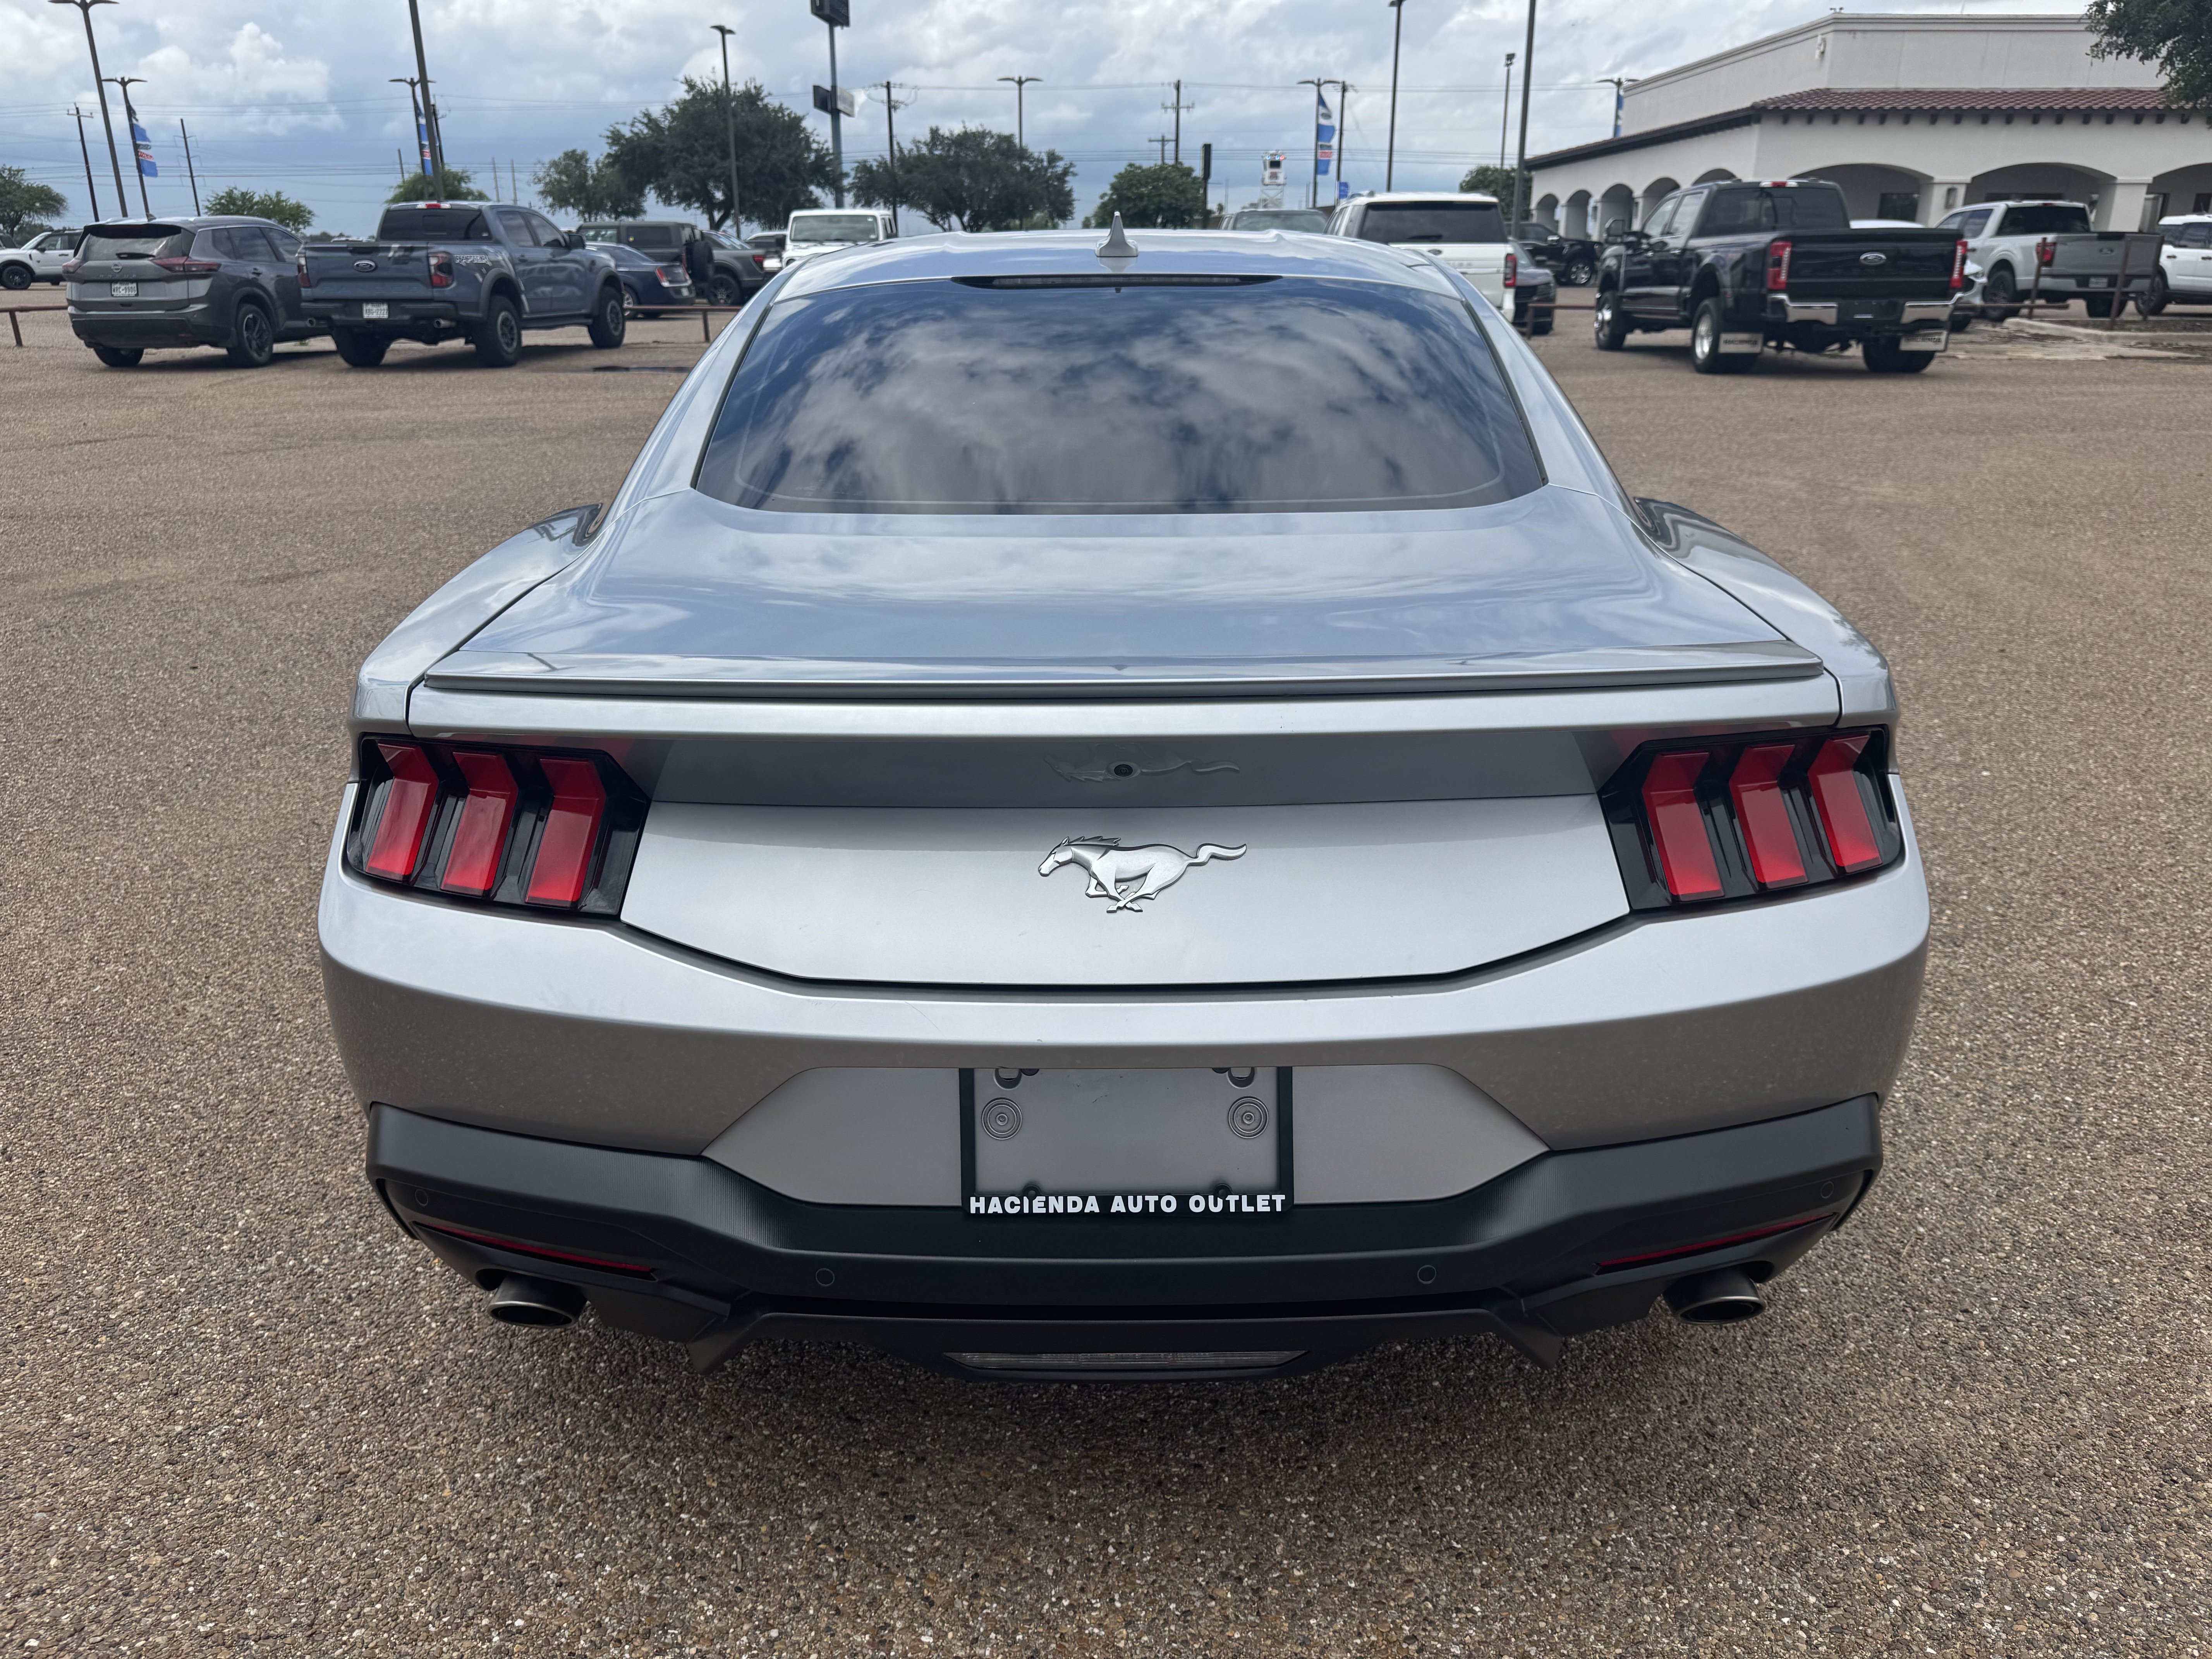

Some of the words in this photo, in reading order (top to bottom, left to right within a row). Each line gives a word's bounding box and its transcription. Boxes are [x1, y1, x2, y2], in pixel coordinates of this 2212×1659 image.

[970, 1195, 1100, 1214] HACIENDA
[1110, 1195, 1177, 1213] AUTO
[1189, 1194, 1285, 1212] OUTLET
